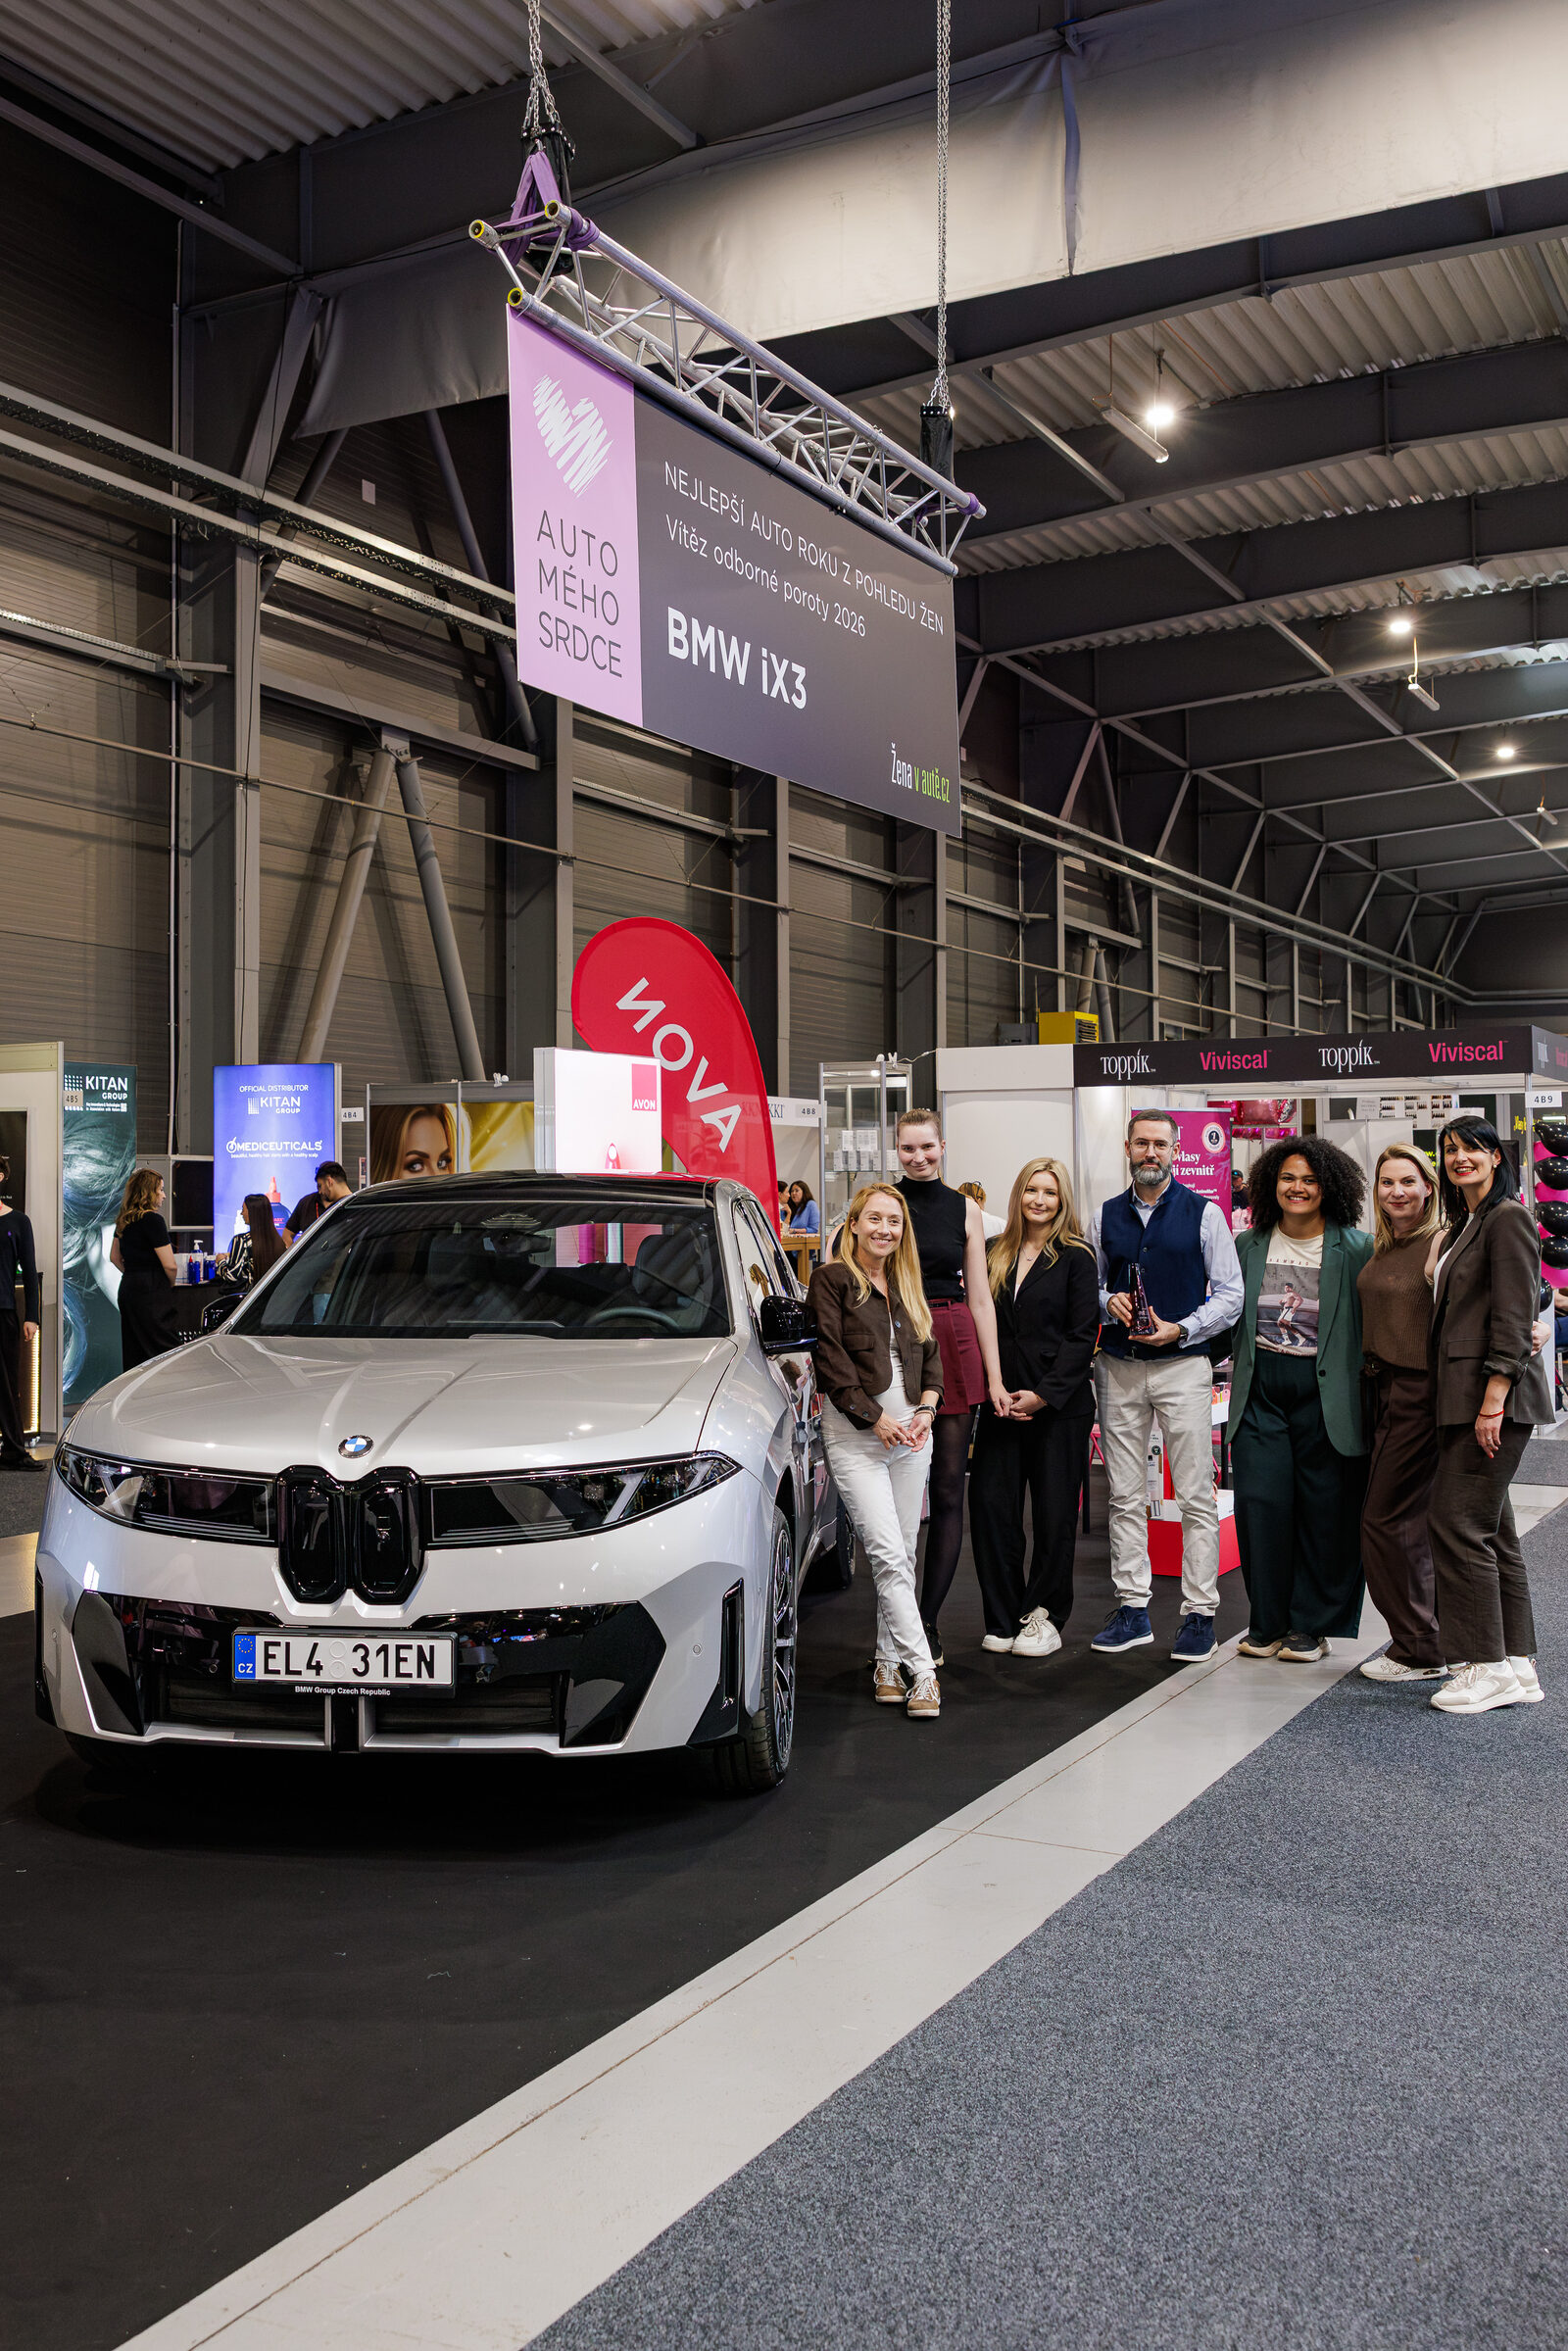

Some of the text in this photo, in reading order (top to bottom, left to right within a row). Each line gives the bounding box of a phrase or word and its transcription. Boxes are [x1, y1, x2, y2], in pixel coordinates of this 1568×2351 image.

[537, 510, 617, 576] AUTO
[664, 461, 944, 635] NEJLEPŠÍ AUTO ROKU Z POHLEDU ŽEN
[665, 514, 865, 637] Vítěz odborné poroty 2026
[539, 559, 618, 626] MÉHO
[539, 611, 622, 678] SRDCE
[667, 606, 808, 710] BMW iX3
[891, 742, 912, 789] Žena
[1200, 1050, 1268, 1071] Viviscal
[1429, 1041, 1503, 1062] Viviscal
[85, 1076, 127, 1091] KITAN
[102, 1092, 127, 1101] GROUP
[260, 1097, 301, 1107] KITAN
[633, 1099, 656, 1110] AVON
[236, 1141, 322, 1151] MEDICEUTICALS
[1180, 1164, 1215, 1176] zevnitř
[237, 1663, 254, 1674] CZ
[264, 1641, 435, 1679] EL4 31EN
[315, 1686, 336, 1695] Group
